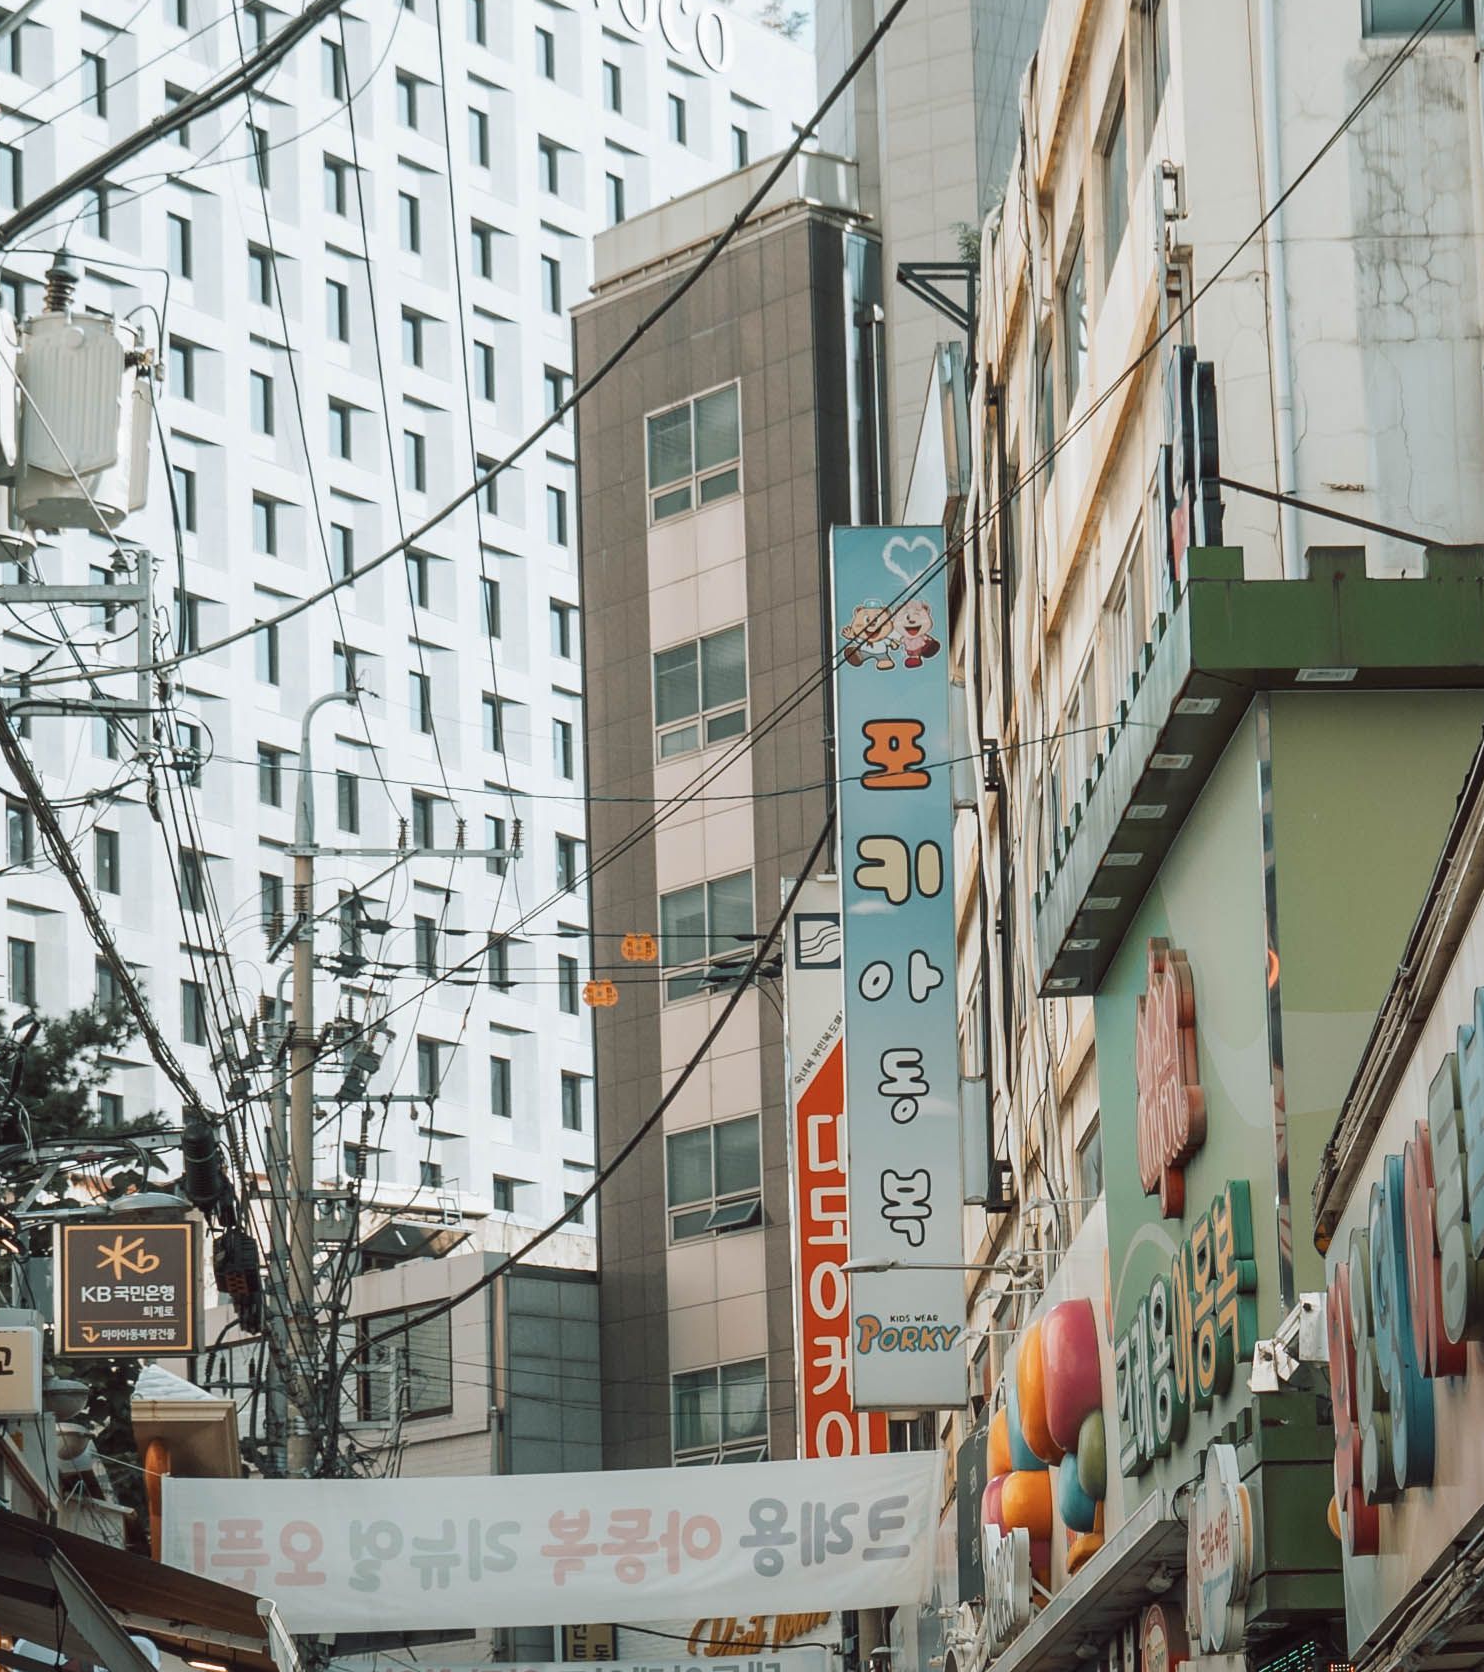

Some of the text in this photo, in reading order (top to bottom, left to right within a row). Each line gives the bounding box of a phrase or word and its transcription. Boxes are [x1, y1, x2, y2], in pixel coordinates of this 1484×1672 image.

[854, 718, 944, 1248] 포키아동복
[142, 1305, 175, 1317] 퇴계로
[890, 1313, 939, 1323] KIDS WEAR
[856, 1314, 961, 1355] PORKY
